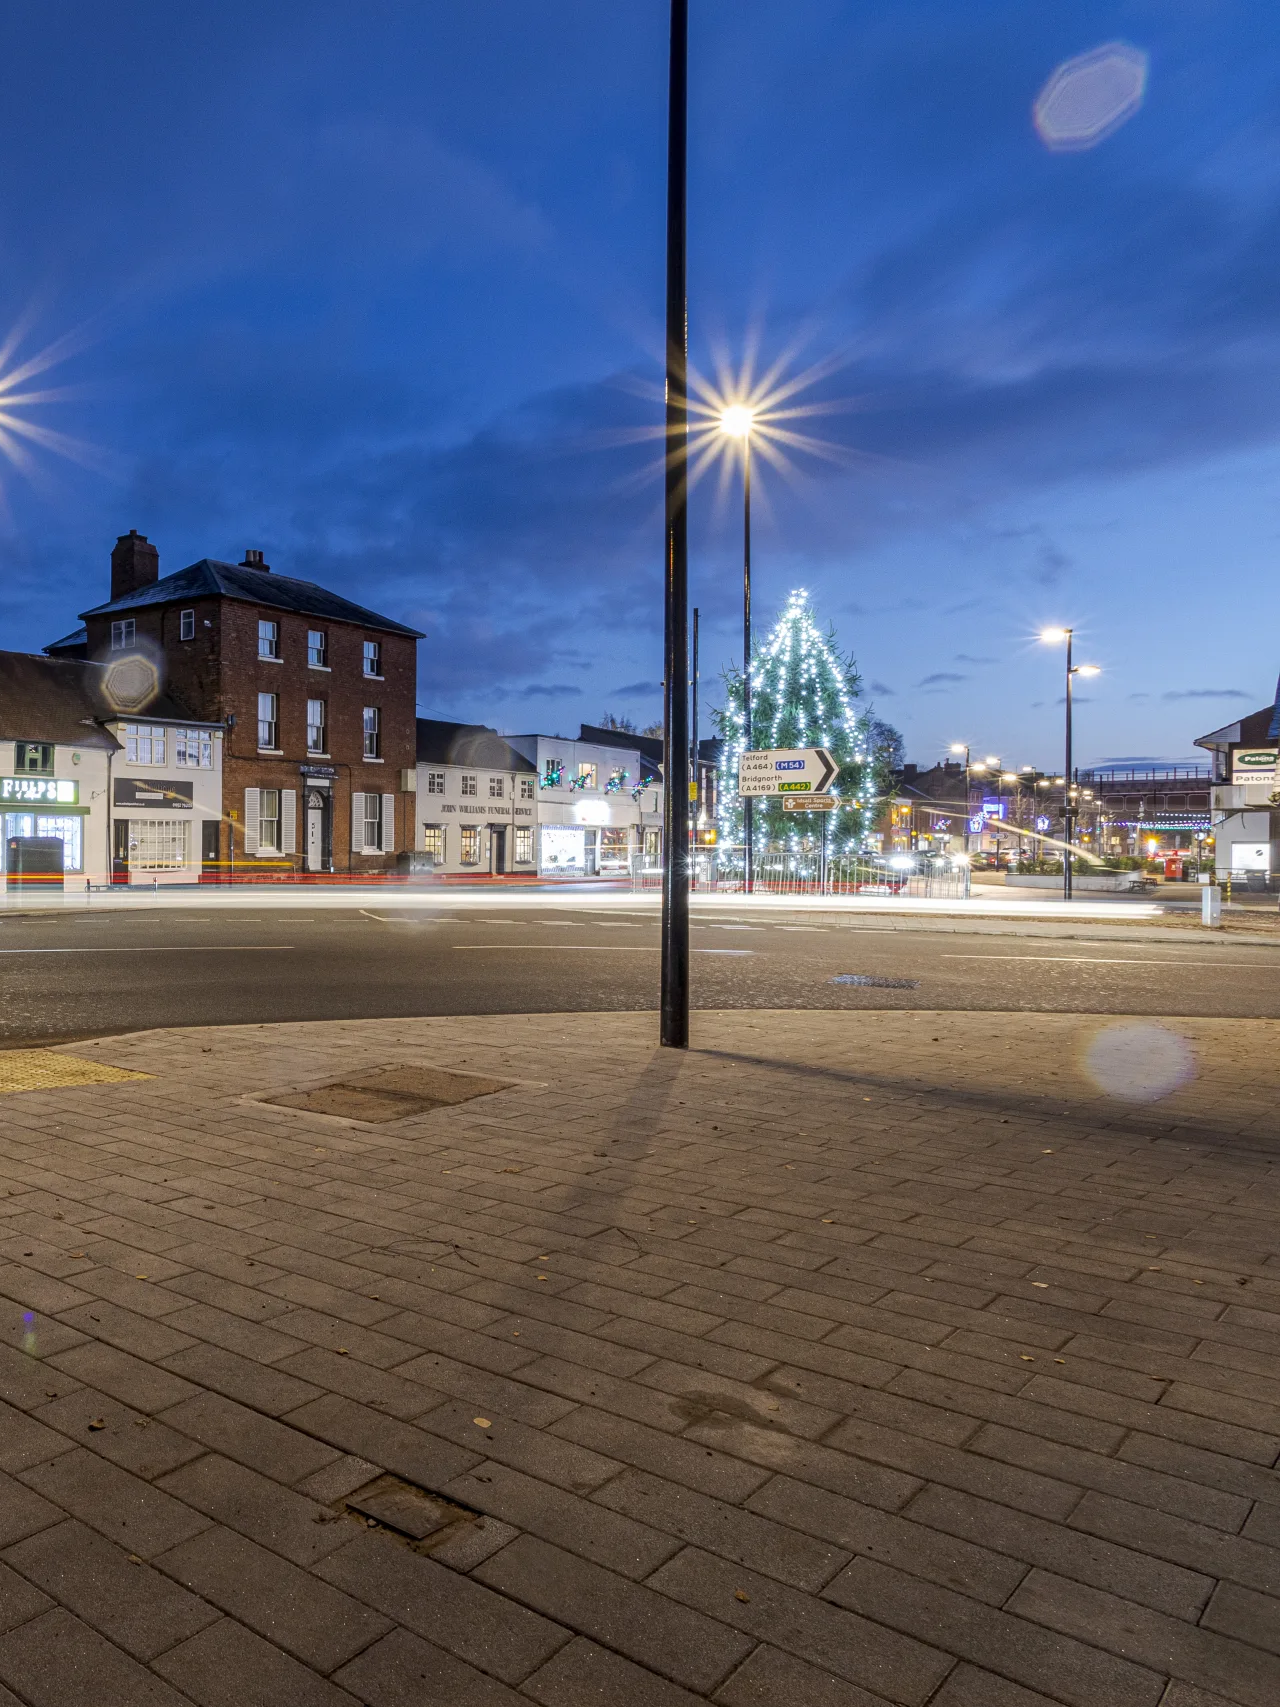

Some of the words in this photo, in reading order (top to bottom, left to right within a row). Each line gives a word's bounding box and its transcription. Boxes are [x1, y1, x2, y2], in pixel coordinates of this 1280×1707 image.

[742, 775, 782, 783] Bridgnorth
[458, 804, 487, 814] WILLIAMS
[488, 806, 511, 815] FUNERAL
[515, 808, 532, 816] ERVICE
